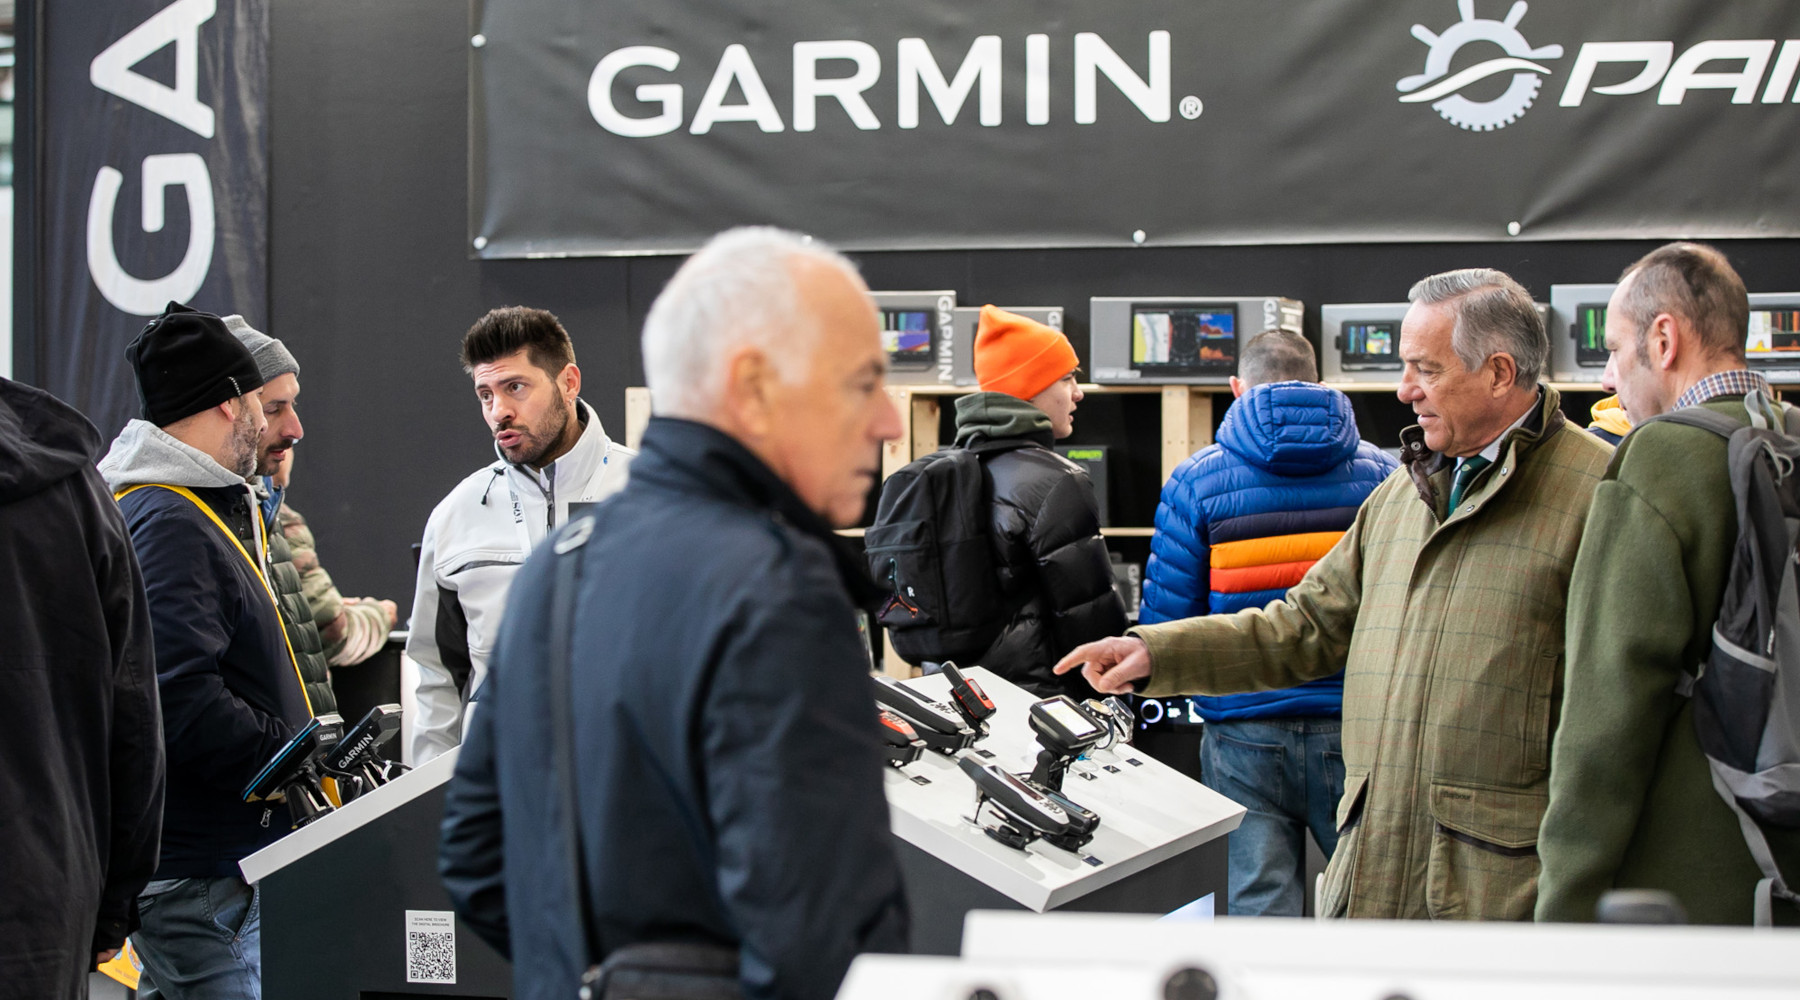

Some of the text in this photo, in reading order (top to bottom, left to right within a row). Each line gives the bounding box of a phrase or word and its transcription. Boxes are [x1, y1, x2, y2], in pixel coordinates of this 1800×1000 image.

[1558, 39, 1800, 107] PAI
[319, 732, 338, 742] GARMIN
[338, 733, 374, 769] GARMIN
[414, 951, 448, 959] GARMIN
